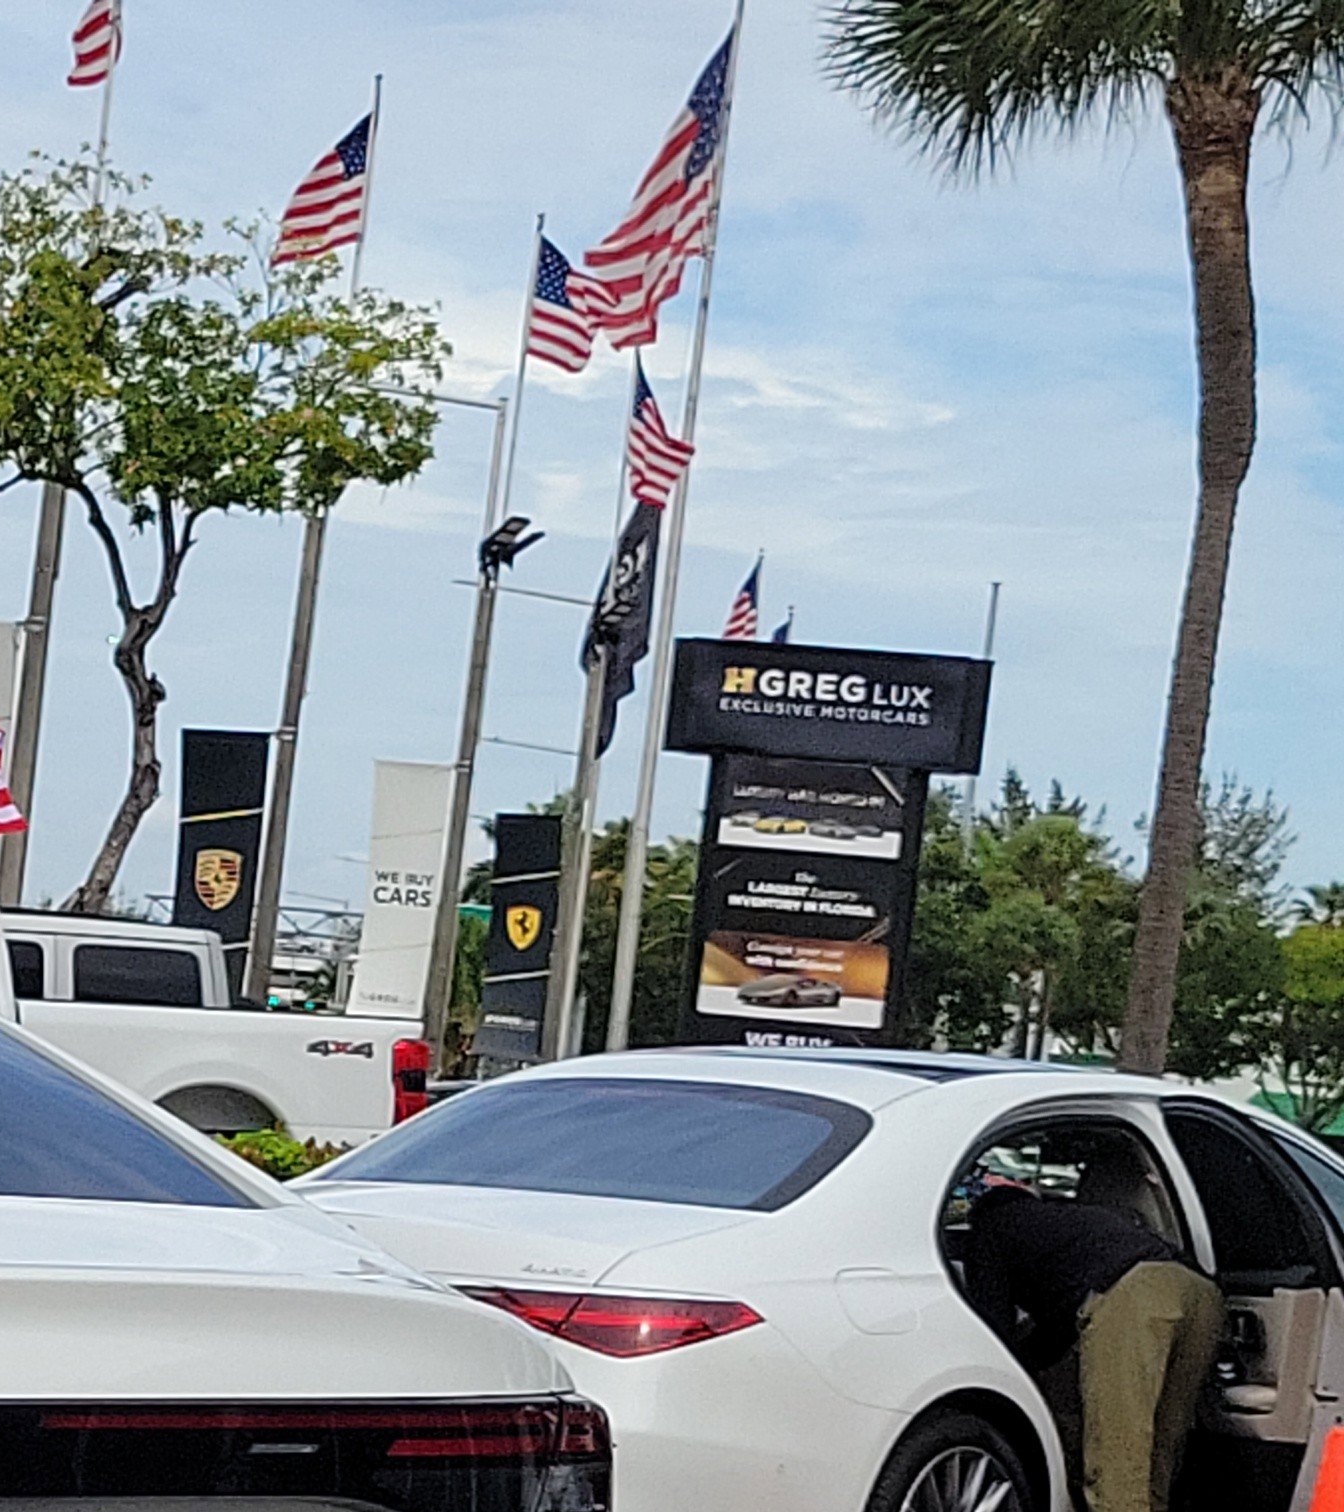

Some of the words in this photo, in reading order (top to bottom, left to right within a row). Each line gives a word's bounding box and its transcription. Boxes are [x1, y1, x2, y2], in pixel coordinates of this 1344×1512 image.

[872, 683, 934, 710] LUX
[718, 697, 816, 718] EXCLUSIVE
[818, 705, 931, 727] MOTORCARS
[375, 871, 400, 885] WE
[405, 874, 435, 887] BUY
[373, 886, 433, 908] CARS
